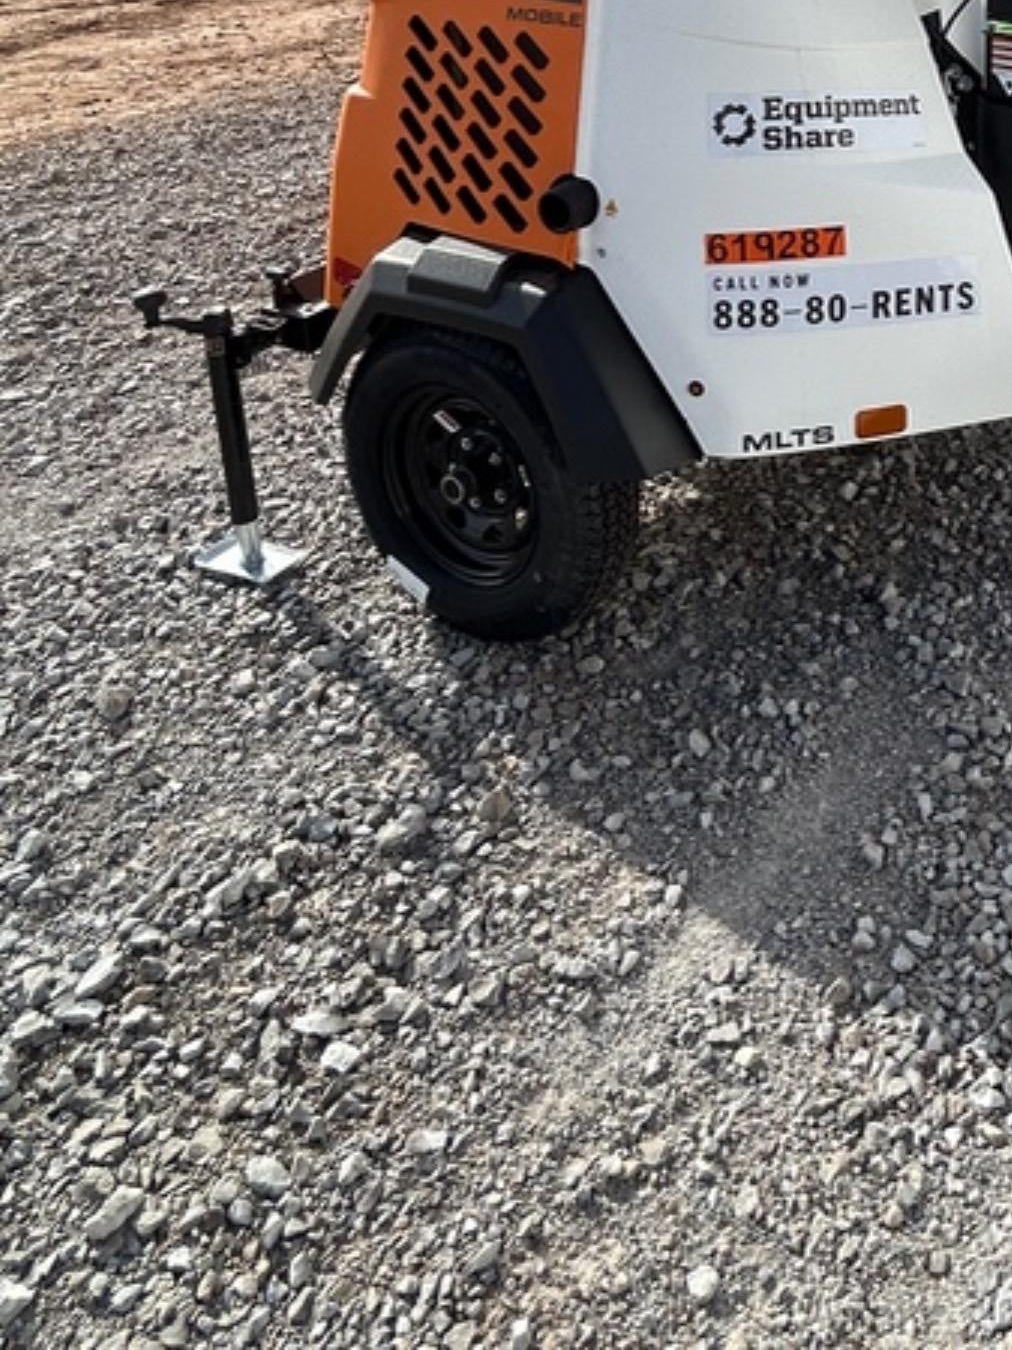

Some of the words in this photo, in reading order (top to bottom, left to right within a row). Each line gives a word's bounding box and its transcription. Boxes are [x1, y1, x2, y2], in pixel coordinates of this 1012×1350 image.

[506, 6, 583, 27] MOBILE
[762, 94, 921, 125] Equipment
[762, 125, 854, 150] Share
[706, 227, 845, 264] 619287
[712, 275, 760, 292] CALL
[769, 273, 810, 289] NOW
[713, 281, 975, 330] 888-80-RENTS
[743, 425, 834, 453] MLTS
